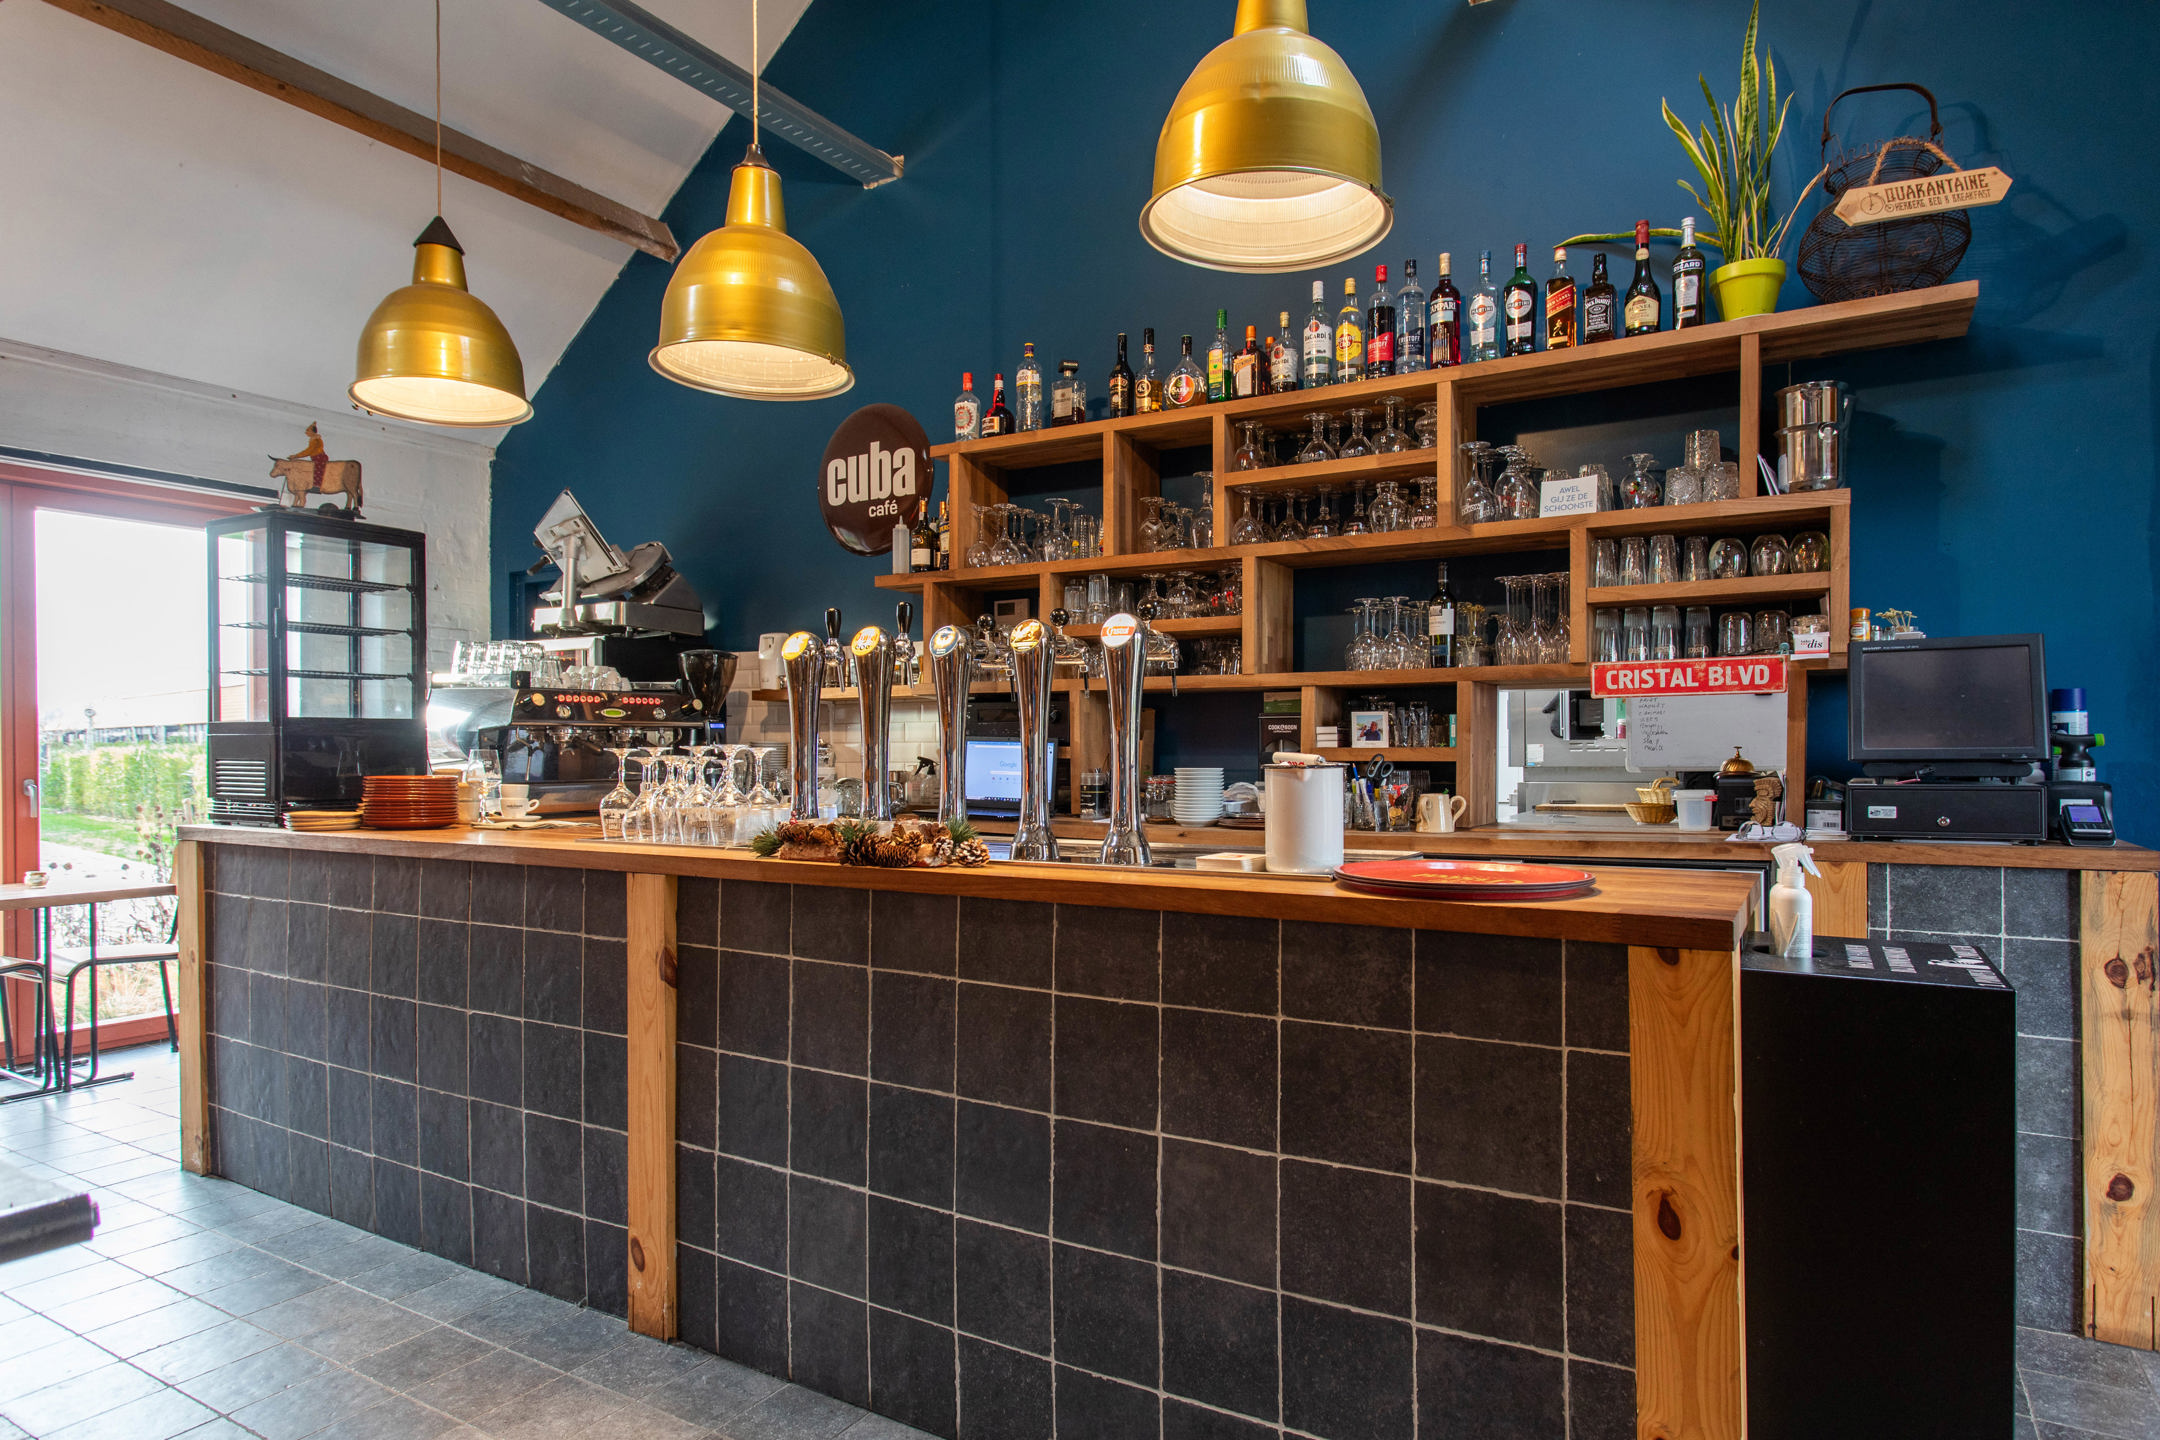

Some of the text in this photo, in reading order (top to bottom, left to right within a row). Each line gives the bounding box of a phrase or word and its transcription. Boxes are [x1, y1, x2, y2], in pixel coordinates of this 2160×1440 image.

[1884, 173, 1989, 203] QUARANTAINE
[1952, 189, 1990, 202] BREAKFAST
[1673, 260, 1700, 273] RICARD
[1471, 305, 1493, 315] MARTINI
[1507, 300, 1530, 309] MARTINI
[827, 441, 916, 506] cuba
[1560, 485, 1580, 494] AWEL
[1551, 492, 1588, 504] GIJ ZE DE
[868, 500, 898, 517] café
[1543, 501, 1593, 513] SCHOONSTE
[1807, 639, 1823, 649] dis
[1605, 664, 1770, 690] CRISTAL BLVD
